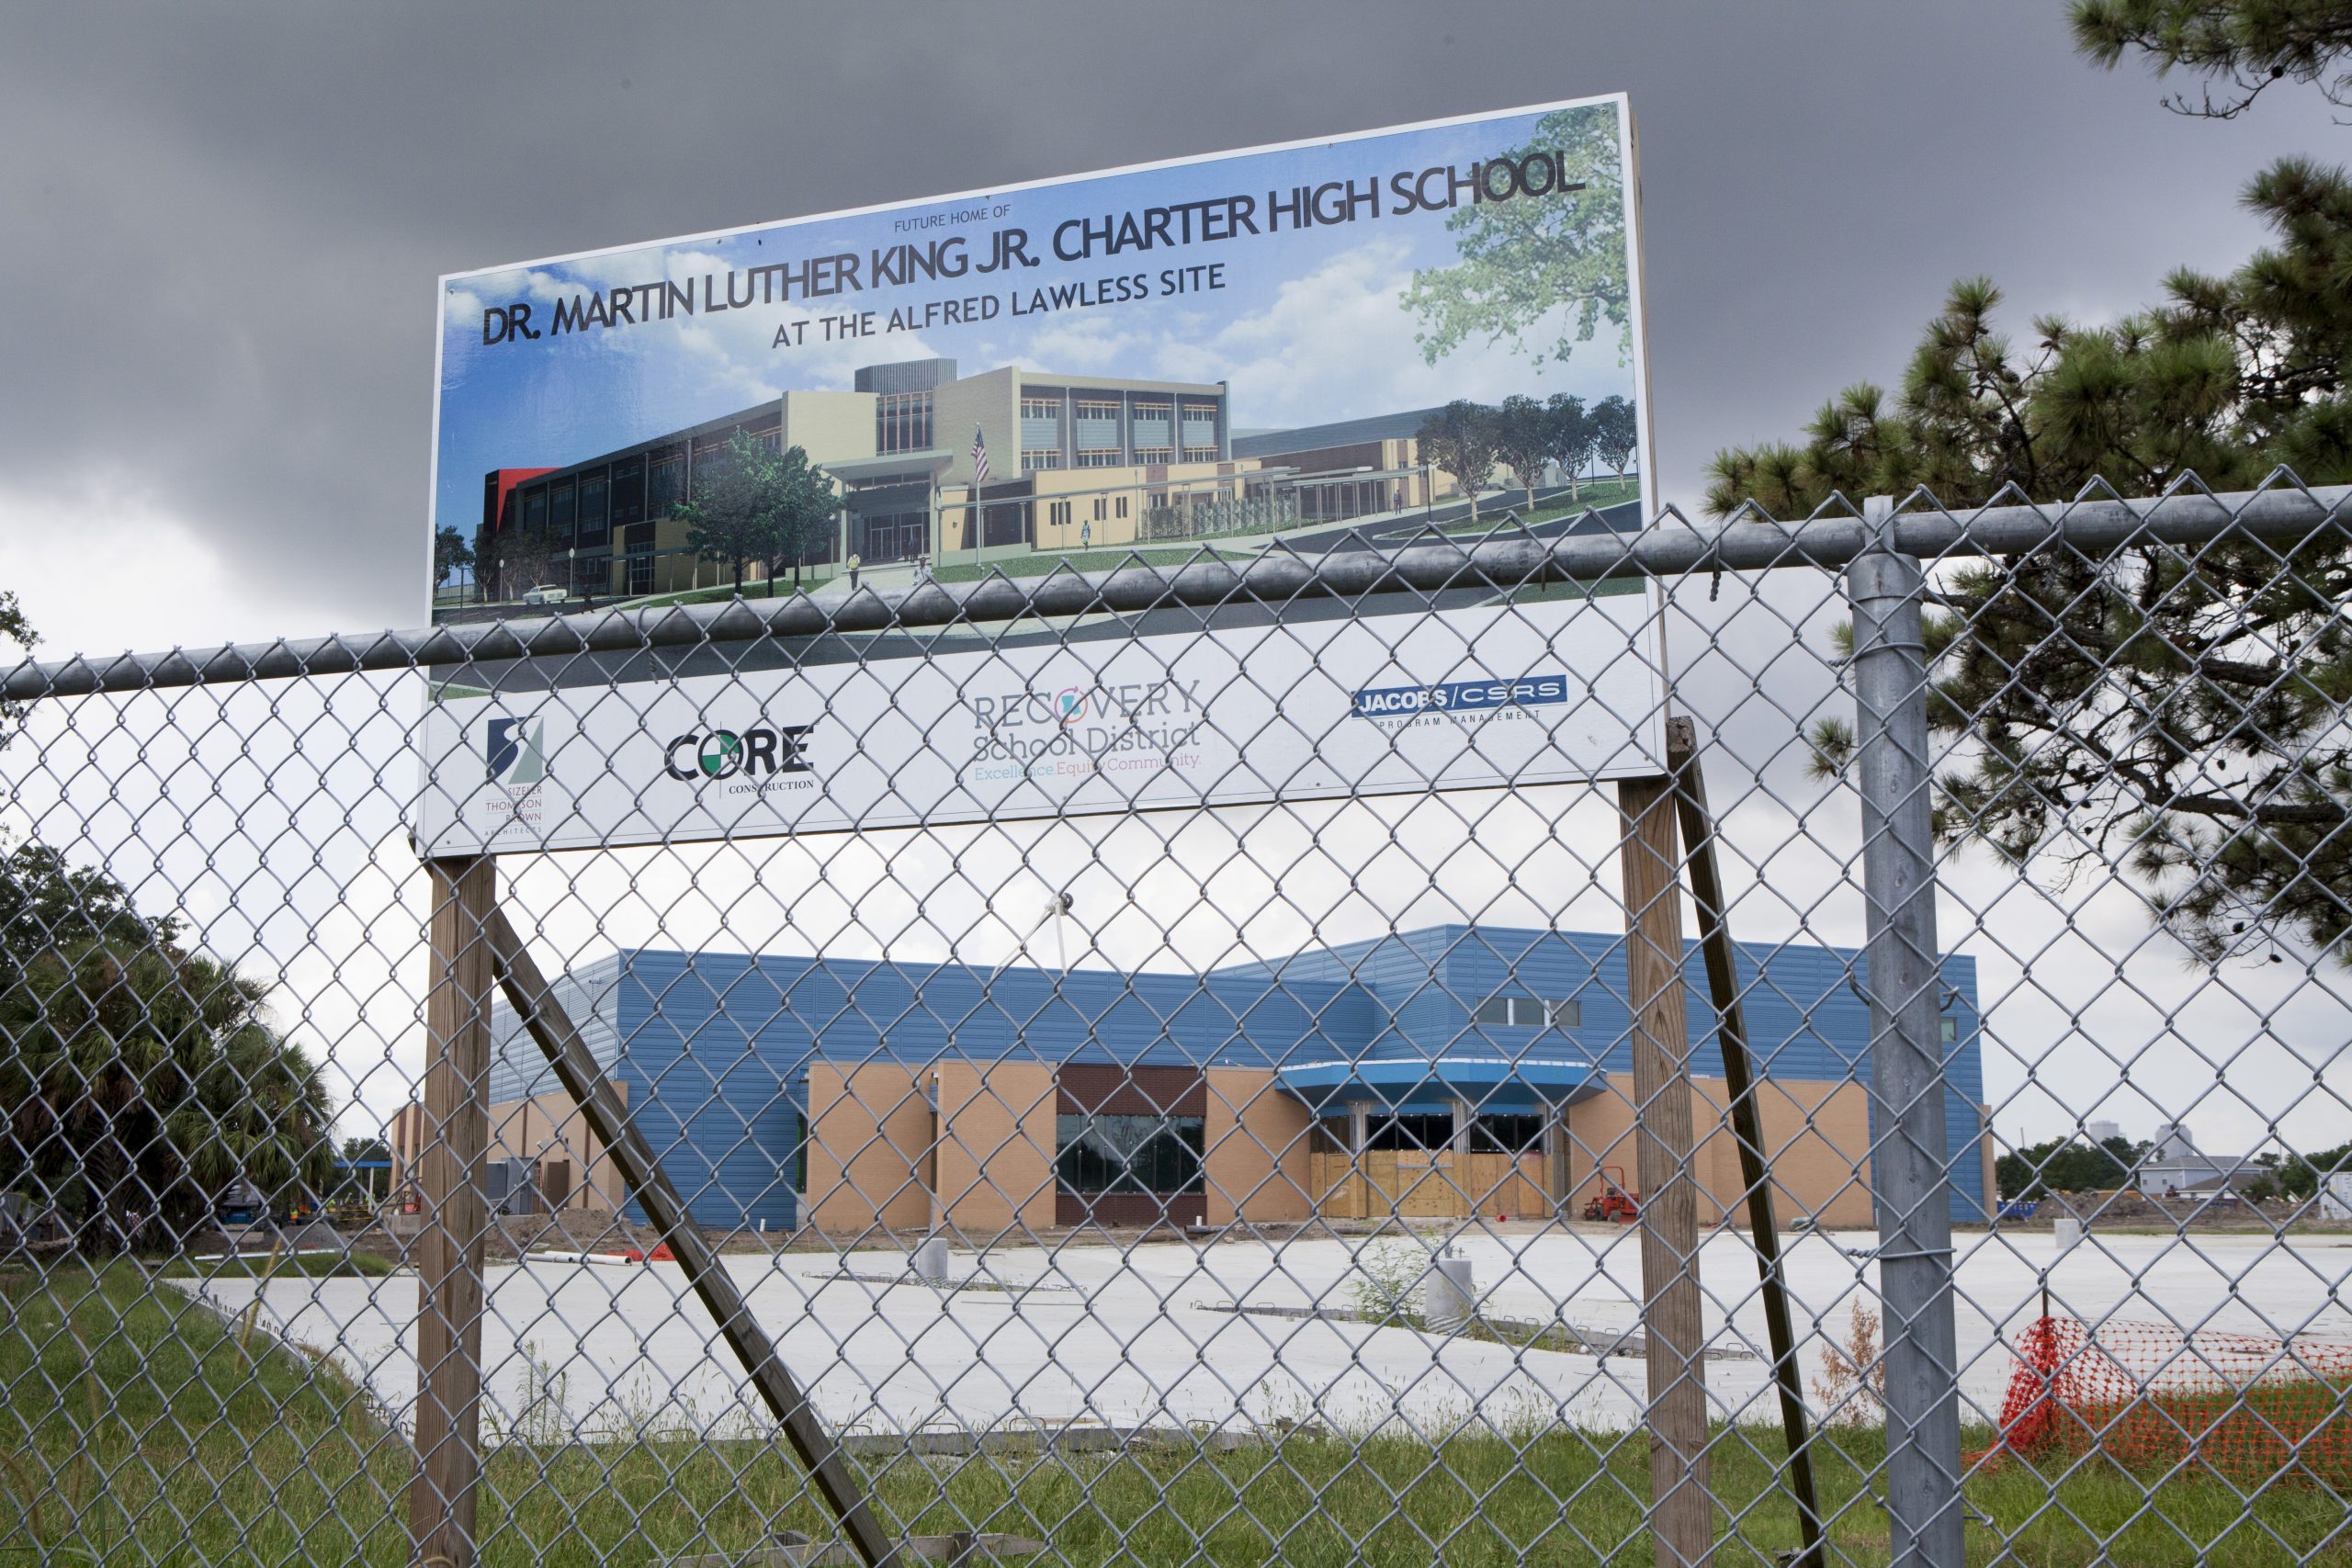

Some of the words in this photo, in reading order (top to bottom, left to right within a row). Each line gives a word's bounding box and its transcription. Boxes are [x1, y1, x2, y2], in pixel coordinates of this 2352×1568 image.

[894, 214, 945, 232] FUTURE
[950, 208, 989, 225] HOME
[993, 204, 1011, 219] OF
[482, 303, 540, 346] DR.
[551, 277, 695, 336] MARTIN
[706, 253, 862, 313] LUTHER
[871, 237, 968, 288] KING
[977, 229, 1040, 274] JR.
[1052, 195, 1260, 262] CHARTER
[1269, 176, 1379, 232] HIGH
[1392, 150, 1586, 216] SCHOOL
[772, 321, 809, 349] AT
[820, 311, 876, 341] THE
[887, 294, 1000, 333] ALFRED
[1012, 274, 1148, 316] LAWLESS
[1160, 263, 1226, 297] SITE
[664, 725, 814, 781] CORE
[974, 726, 1076, 761] School
[1087, 721, 1201, 754] District
[729, 780, 814, 795] CONSRUCTION
[485, 799, 542, 811] THOMSON
[485, 826, 542, 836] ARHITECS
